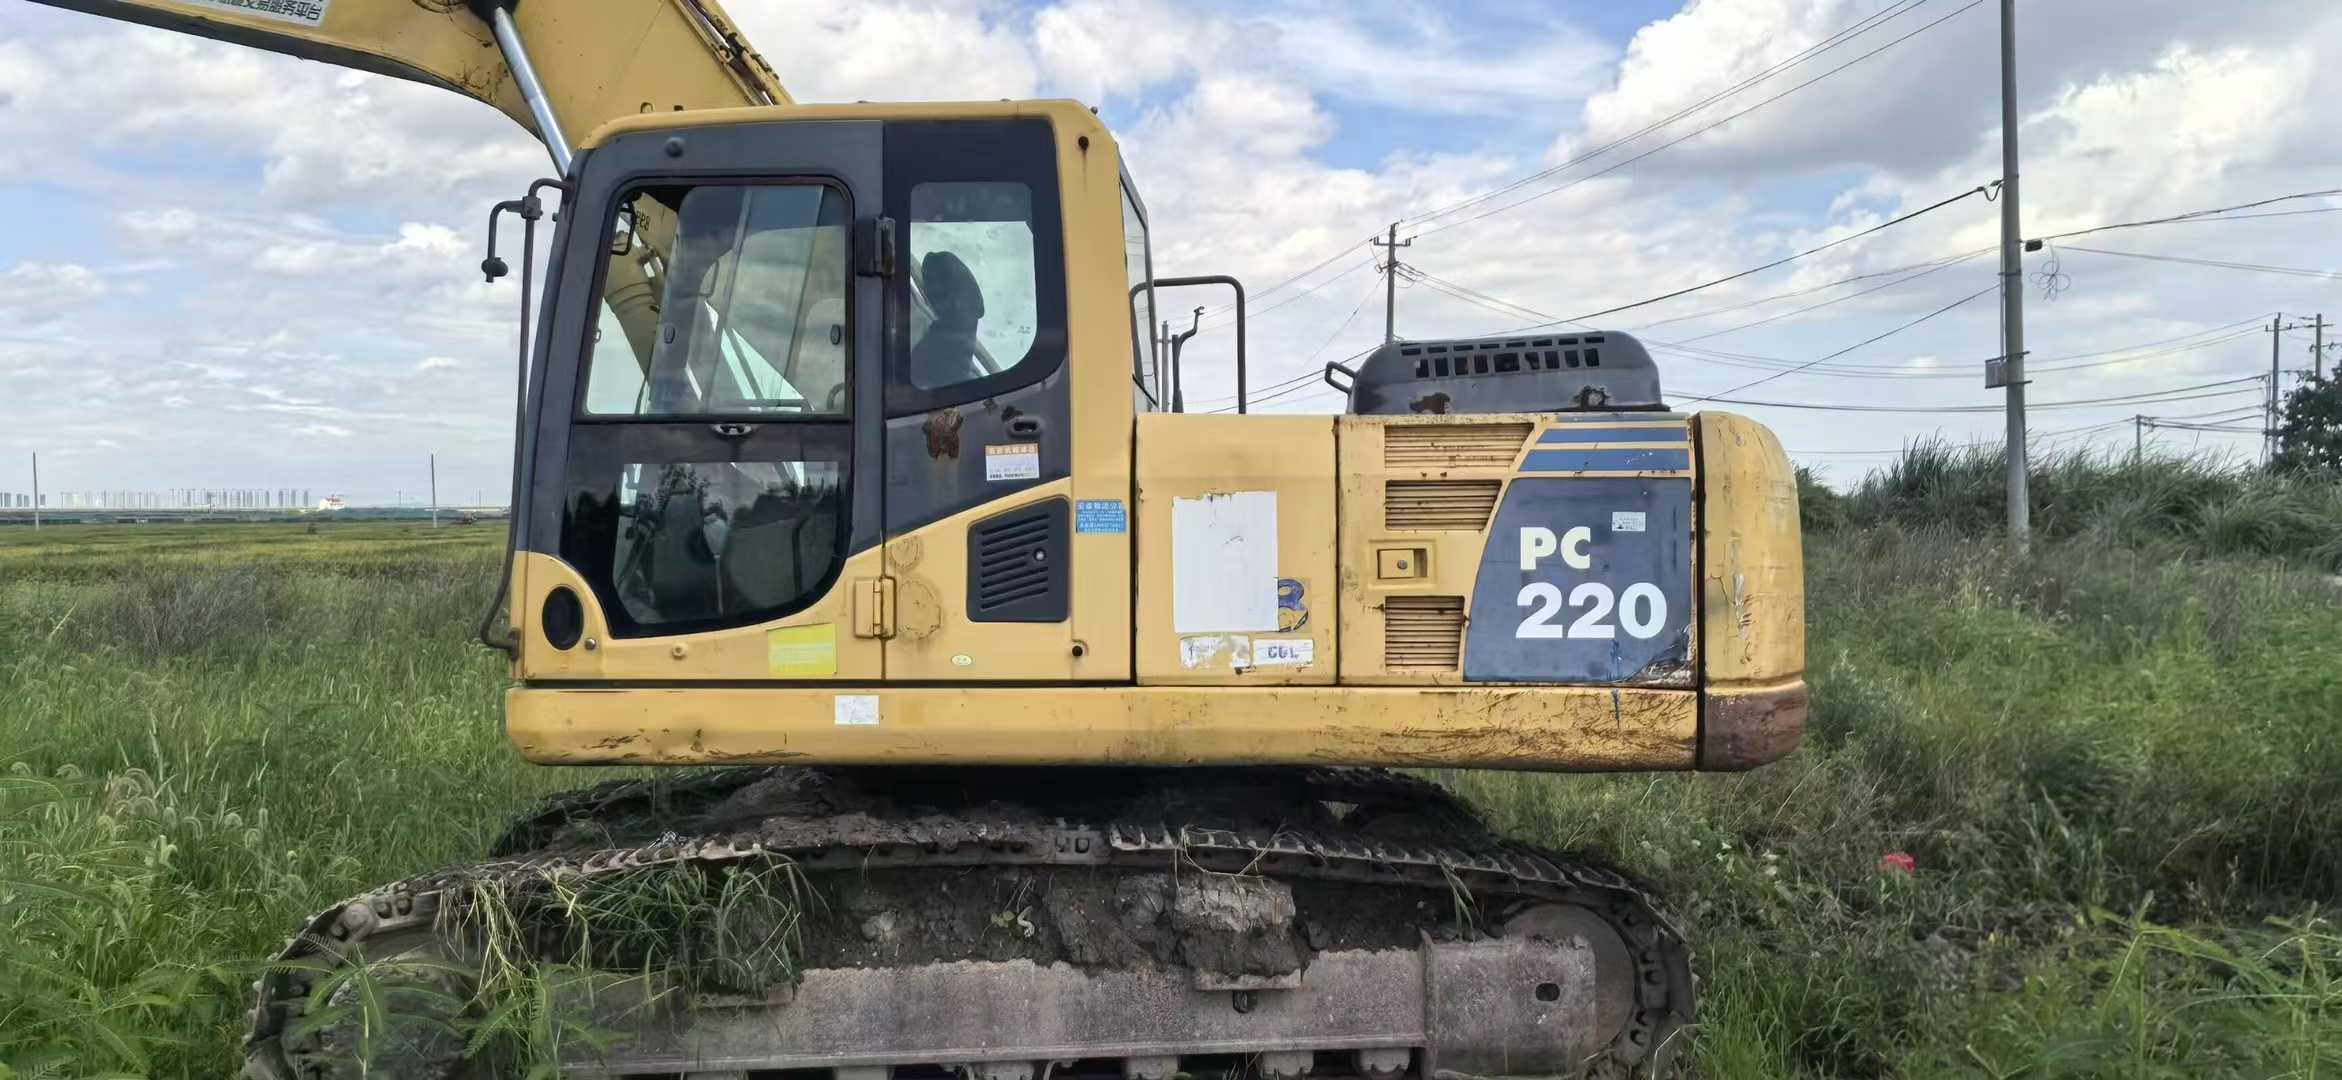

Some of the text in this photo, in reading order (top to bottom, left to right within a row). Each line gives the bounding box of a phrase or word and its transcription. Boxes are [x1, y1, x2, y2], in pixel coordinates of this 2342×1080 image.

[217, 0, 322, 20] 交易服务平台
[1519, 526, 1591, 571] PC
[1515, 582, 1668, 640] 220
